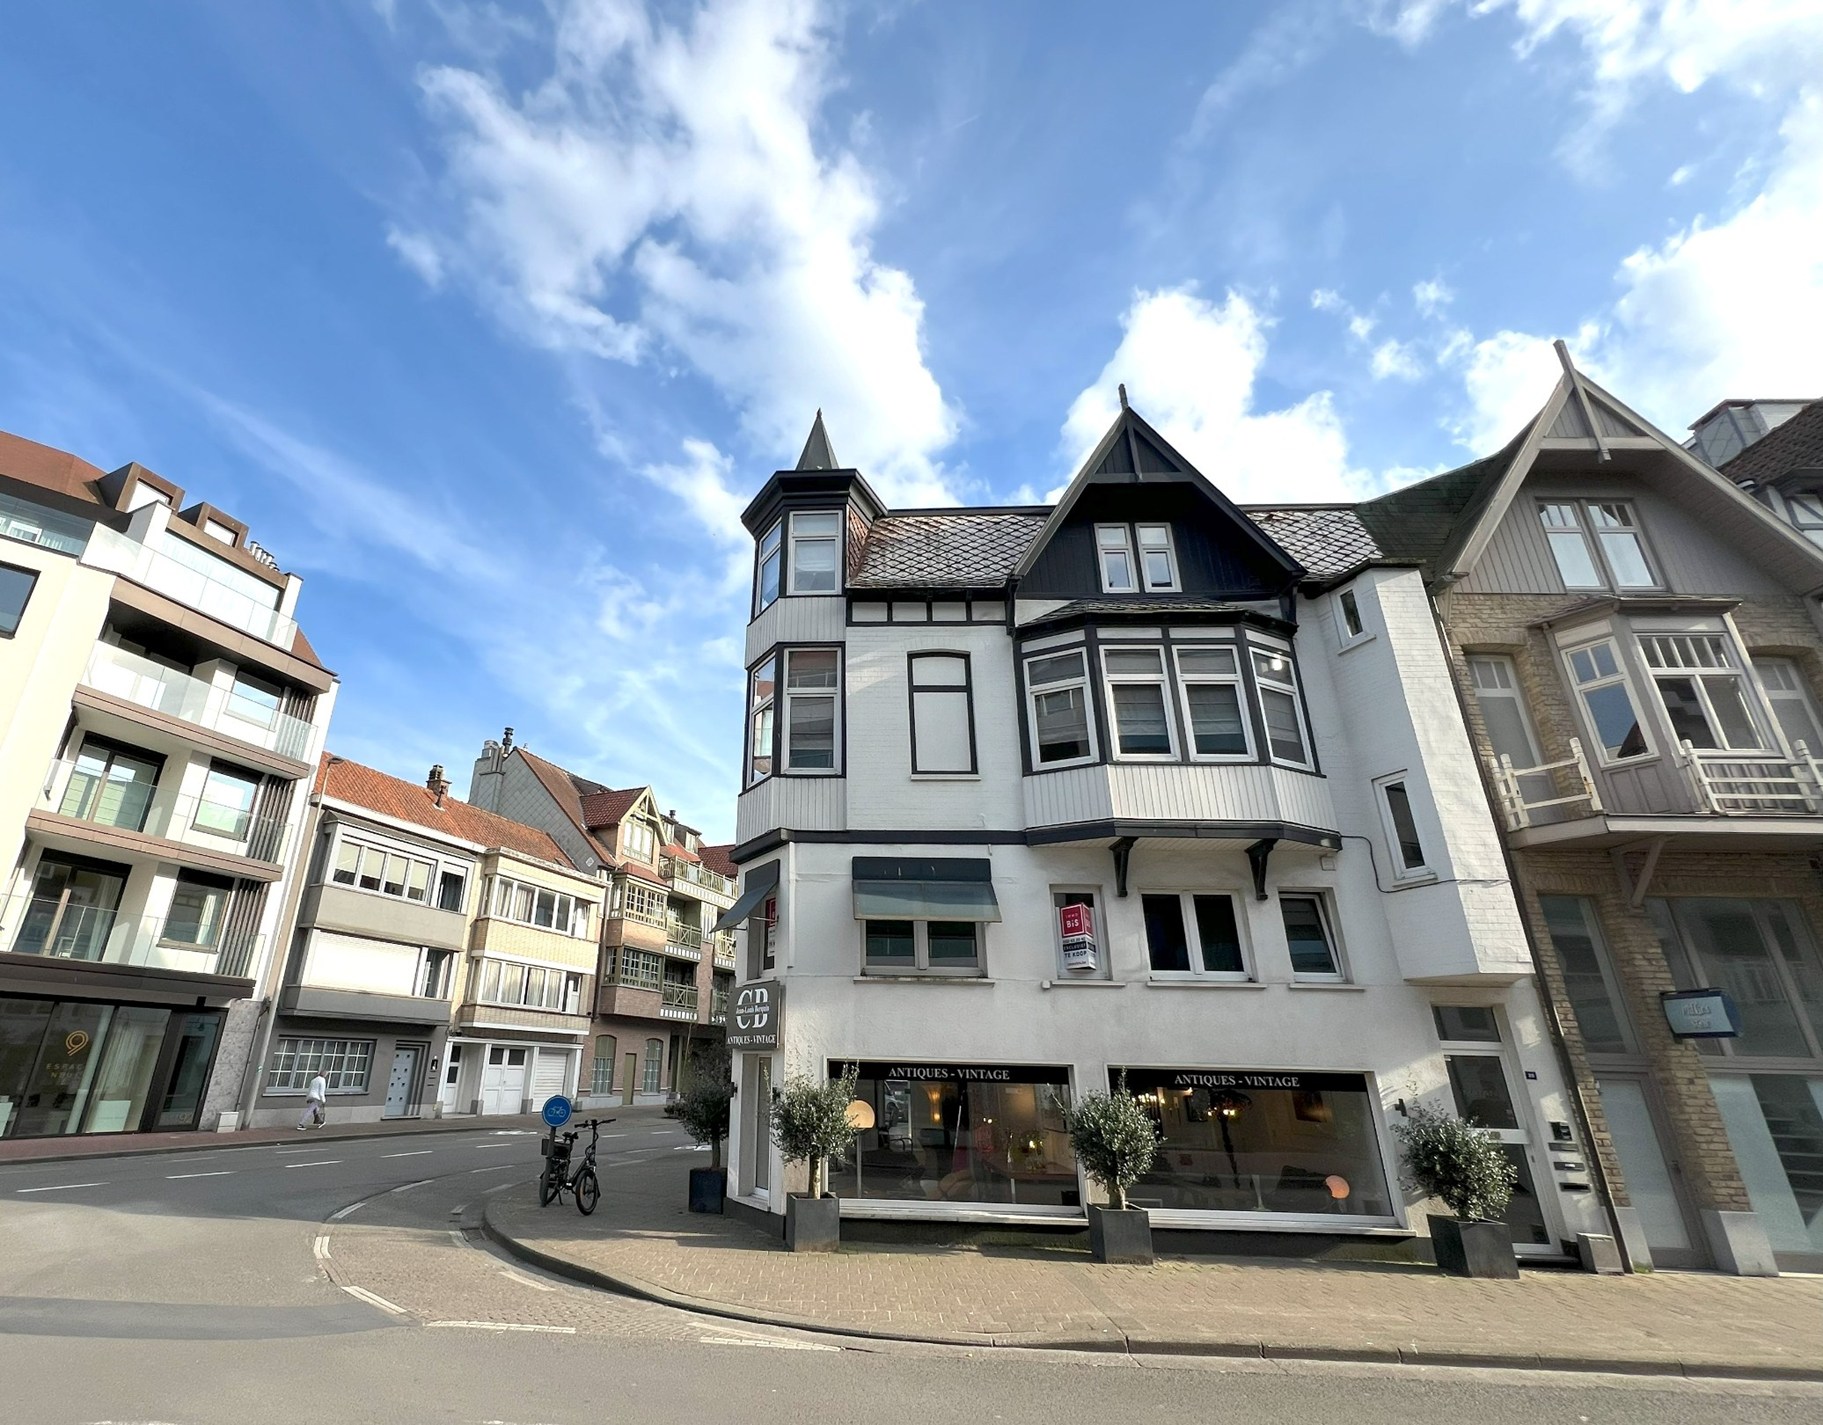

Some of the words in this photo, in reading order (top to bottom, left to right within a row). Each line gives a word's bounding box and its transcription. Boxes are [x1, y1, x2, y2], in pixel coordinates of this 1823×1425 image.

[727, 1035, 750, 1046] ANTIQUES
[753, 1034, 776, 1044] VINTAGE
[888, 1067, 948, 1080] ANTIQUES
[957, 1069, 1010, 1080] VINTAGE
[1174, 1074, 1236, 1087] ANTIQUES
[1244, 1076, 1300, 1087] VINTAGE
